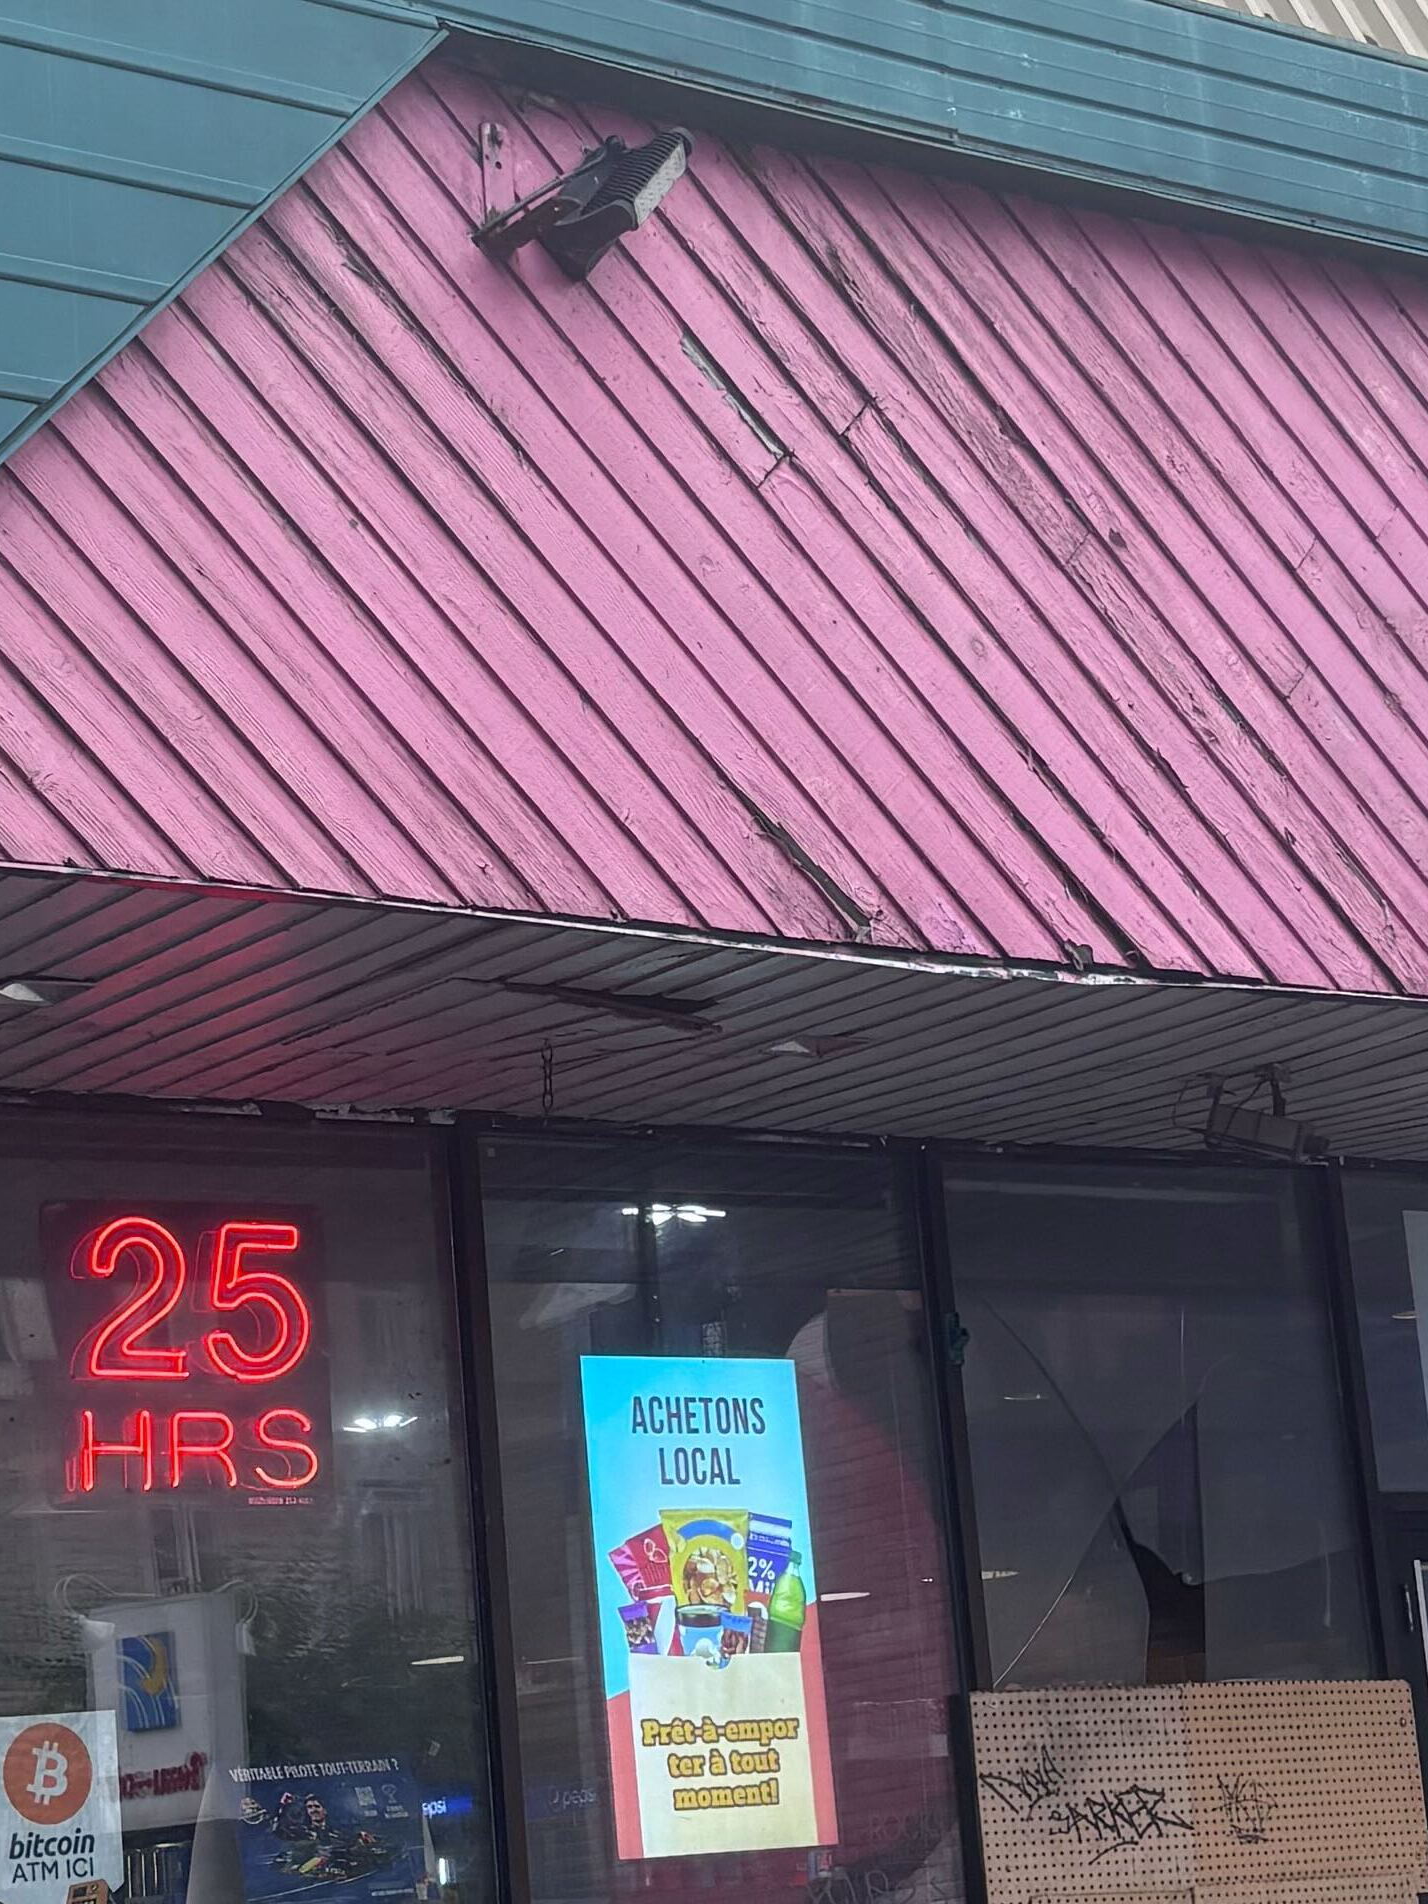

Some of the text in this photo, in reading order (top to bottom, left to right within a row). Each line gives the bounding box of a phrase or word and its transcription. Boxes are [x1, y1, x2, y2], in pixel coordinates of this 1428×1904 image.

[90, 1215, 312, 1383] 25
[630, 1395, 768, 1436] ACHETONS
[79, 1407, 319, 1492] HRS
[658, 1446, 742, 1486] LOCAL
[747, 1556, 776, 1581] 2%
[668, 1746, 780, 1779] ter à tout
[673, 1777, 780, 1812] moment!
[8, 1827, 95, 1860] bitcoin
[12, 1856, 94, 1884] ATM ICI
